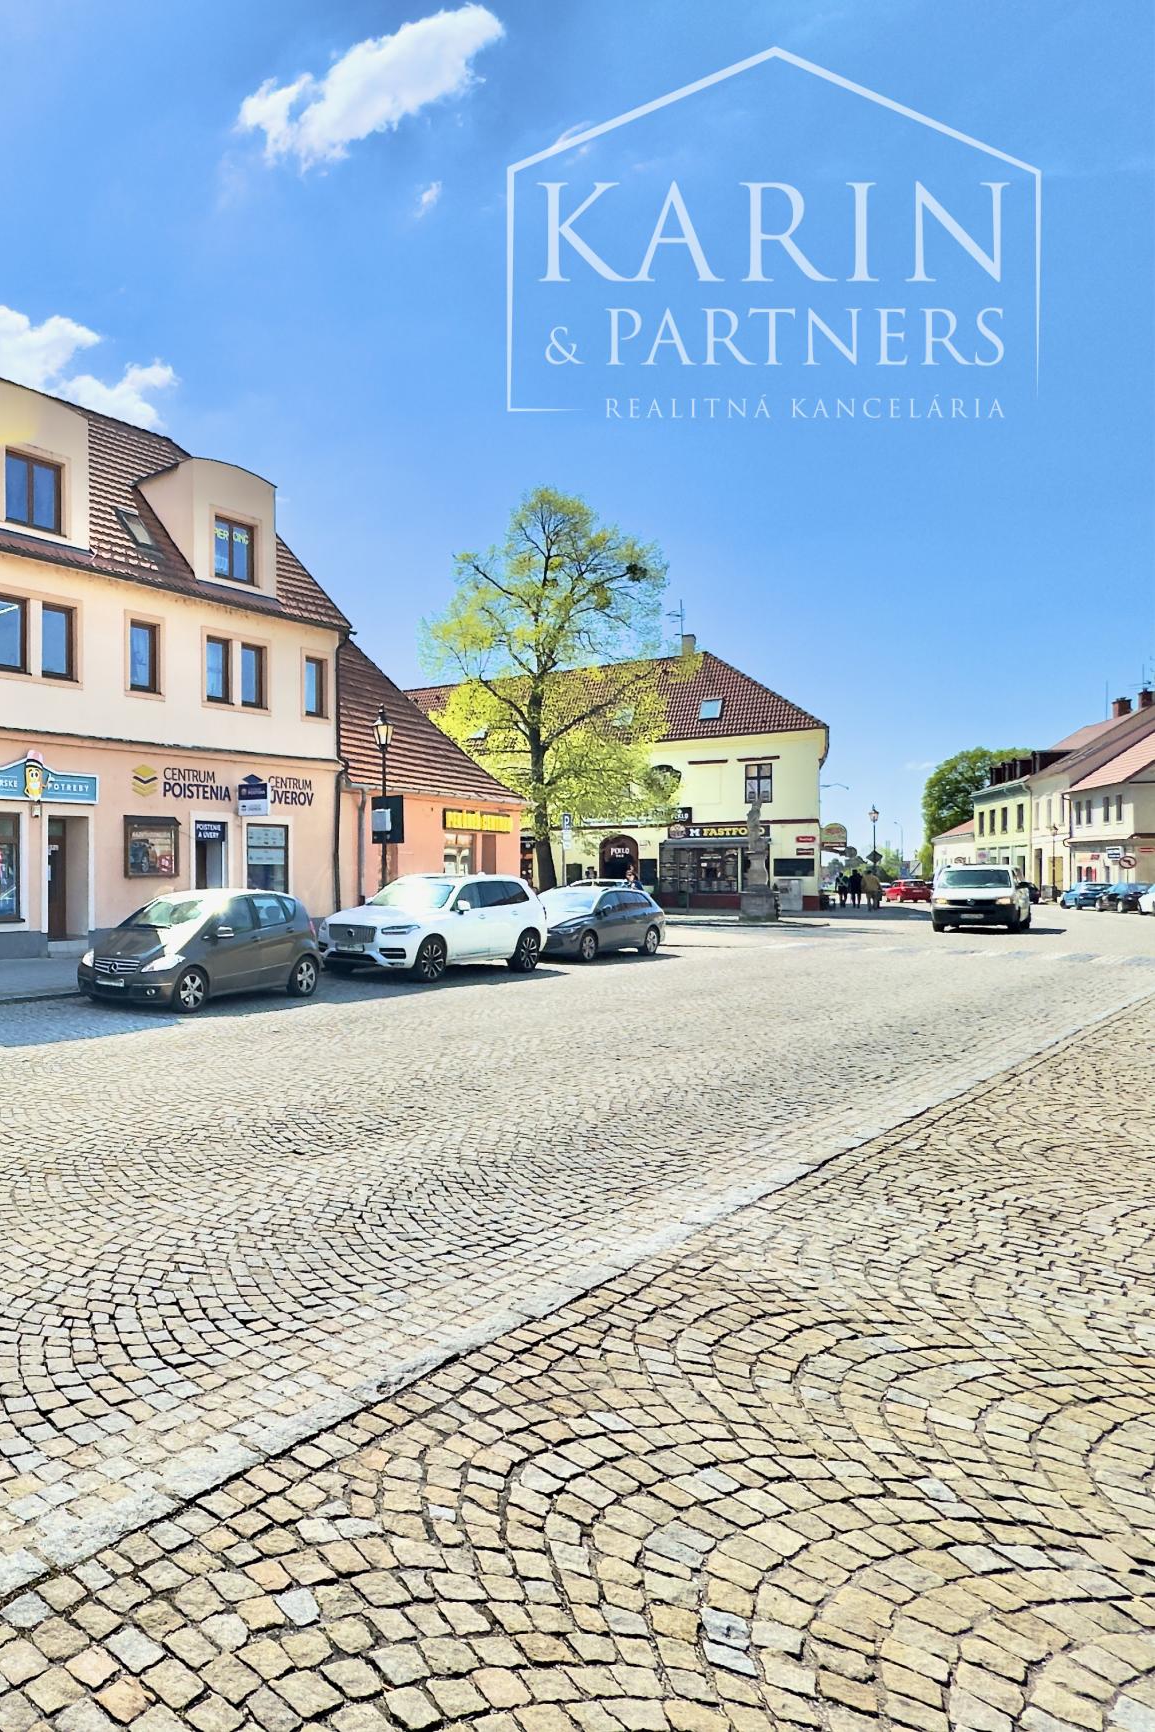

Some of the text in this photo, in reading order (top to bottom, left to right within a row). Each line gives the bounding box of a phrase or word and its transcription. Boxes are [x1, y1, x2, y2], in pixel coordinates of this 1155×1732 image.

[163, 767, 216, 784] CENTRUM
[47, 782, 89, 792] POTREBY
[163, 781, 232, 801] POISTENIA
[268, 776, 312, 791] CENTRUM
[689, 826, 765, 837] M FASTFOD
